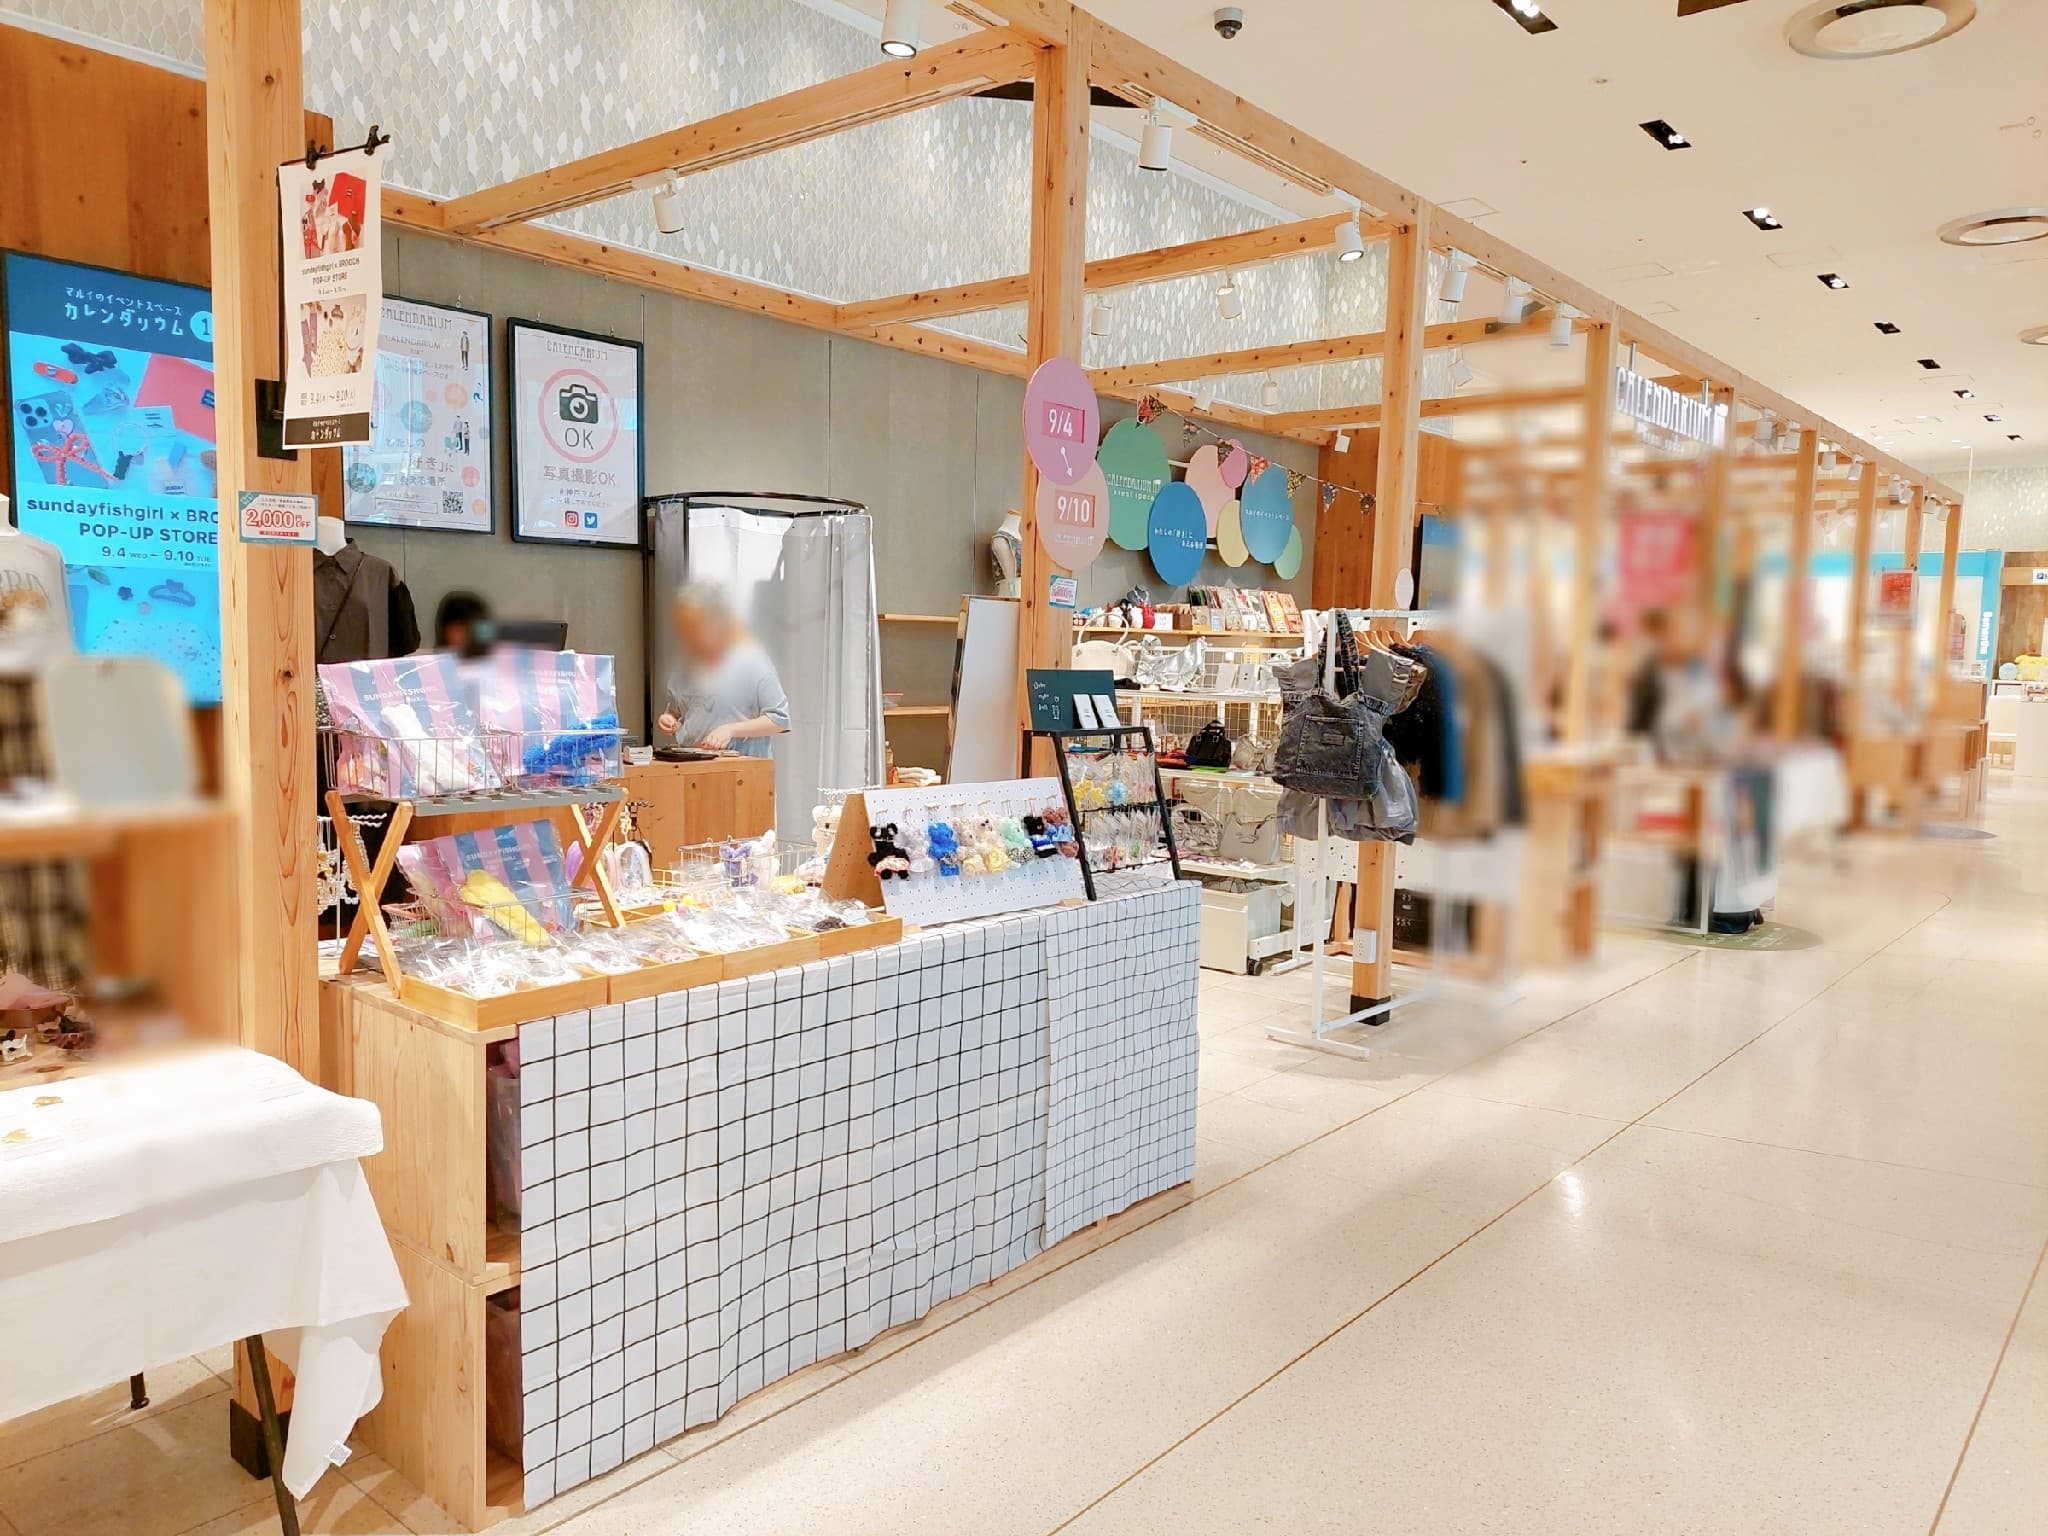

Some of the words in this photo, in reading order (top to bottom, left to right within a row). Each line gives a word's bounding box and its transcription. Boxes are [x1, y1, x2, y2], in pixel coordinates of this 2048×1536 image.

[66, 287, 183, 317] マルイのイベントスペース
[64, 302, 184, 337] カレンダリウム
[1616, 366, 1712, 445] CALENDARIUM
[1048, 408, 1073, 437] 9/4
[564, 427, 594, 450] OK
[543, 465, 616, 486] 写真撮影OK
[27, 499, 164, 522] sundayfishgirl
[246, 508, 295, 528] 2,000
[1057, 496, 1090, 522] 9/10
[79, 522, 154, 540] POP-UP
[159, 528, 218, 545] STORE
[101, 546, 126, 558] 9.4
[164, 550, 194, 562] 9.10
